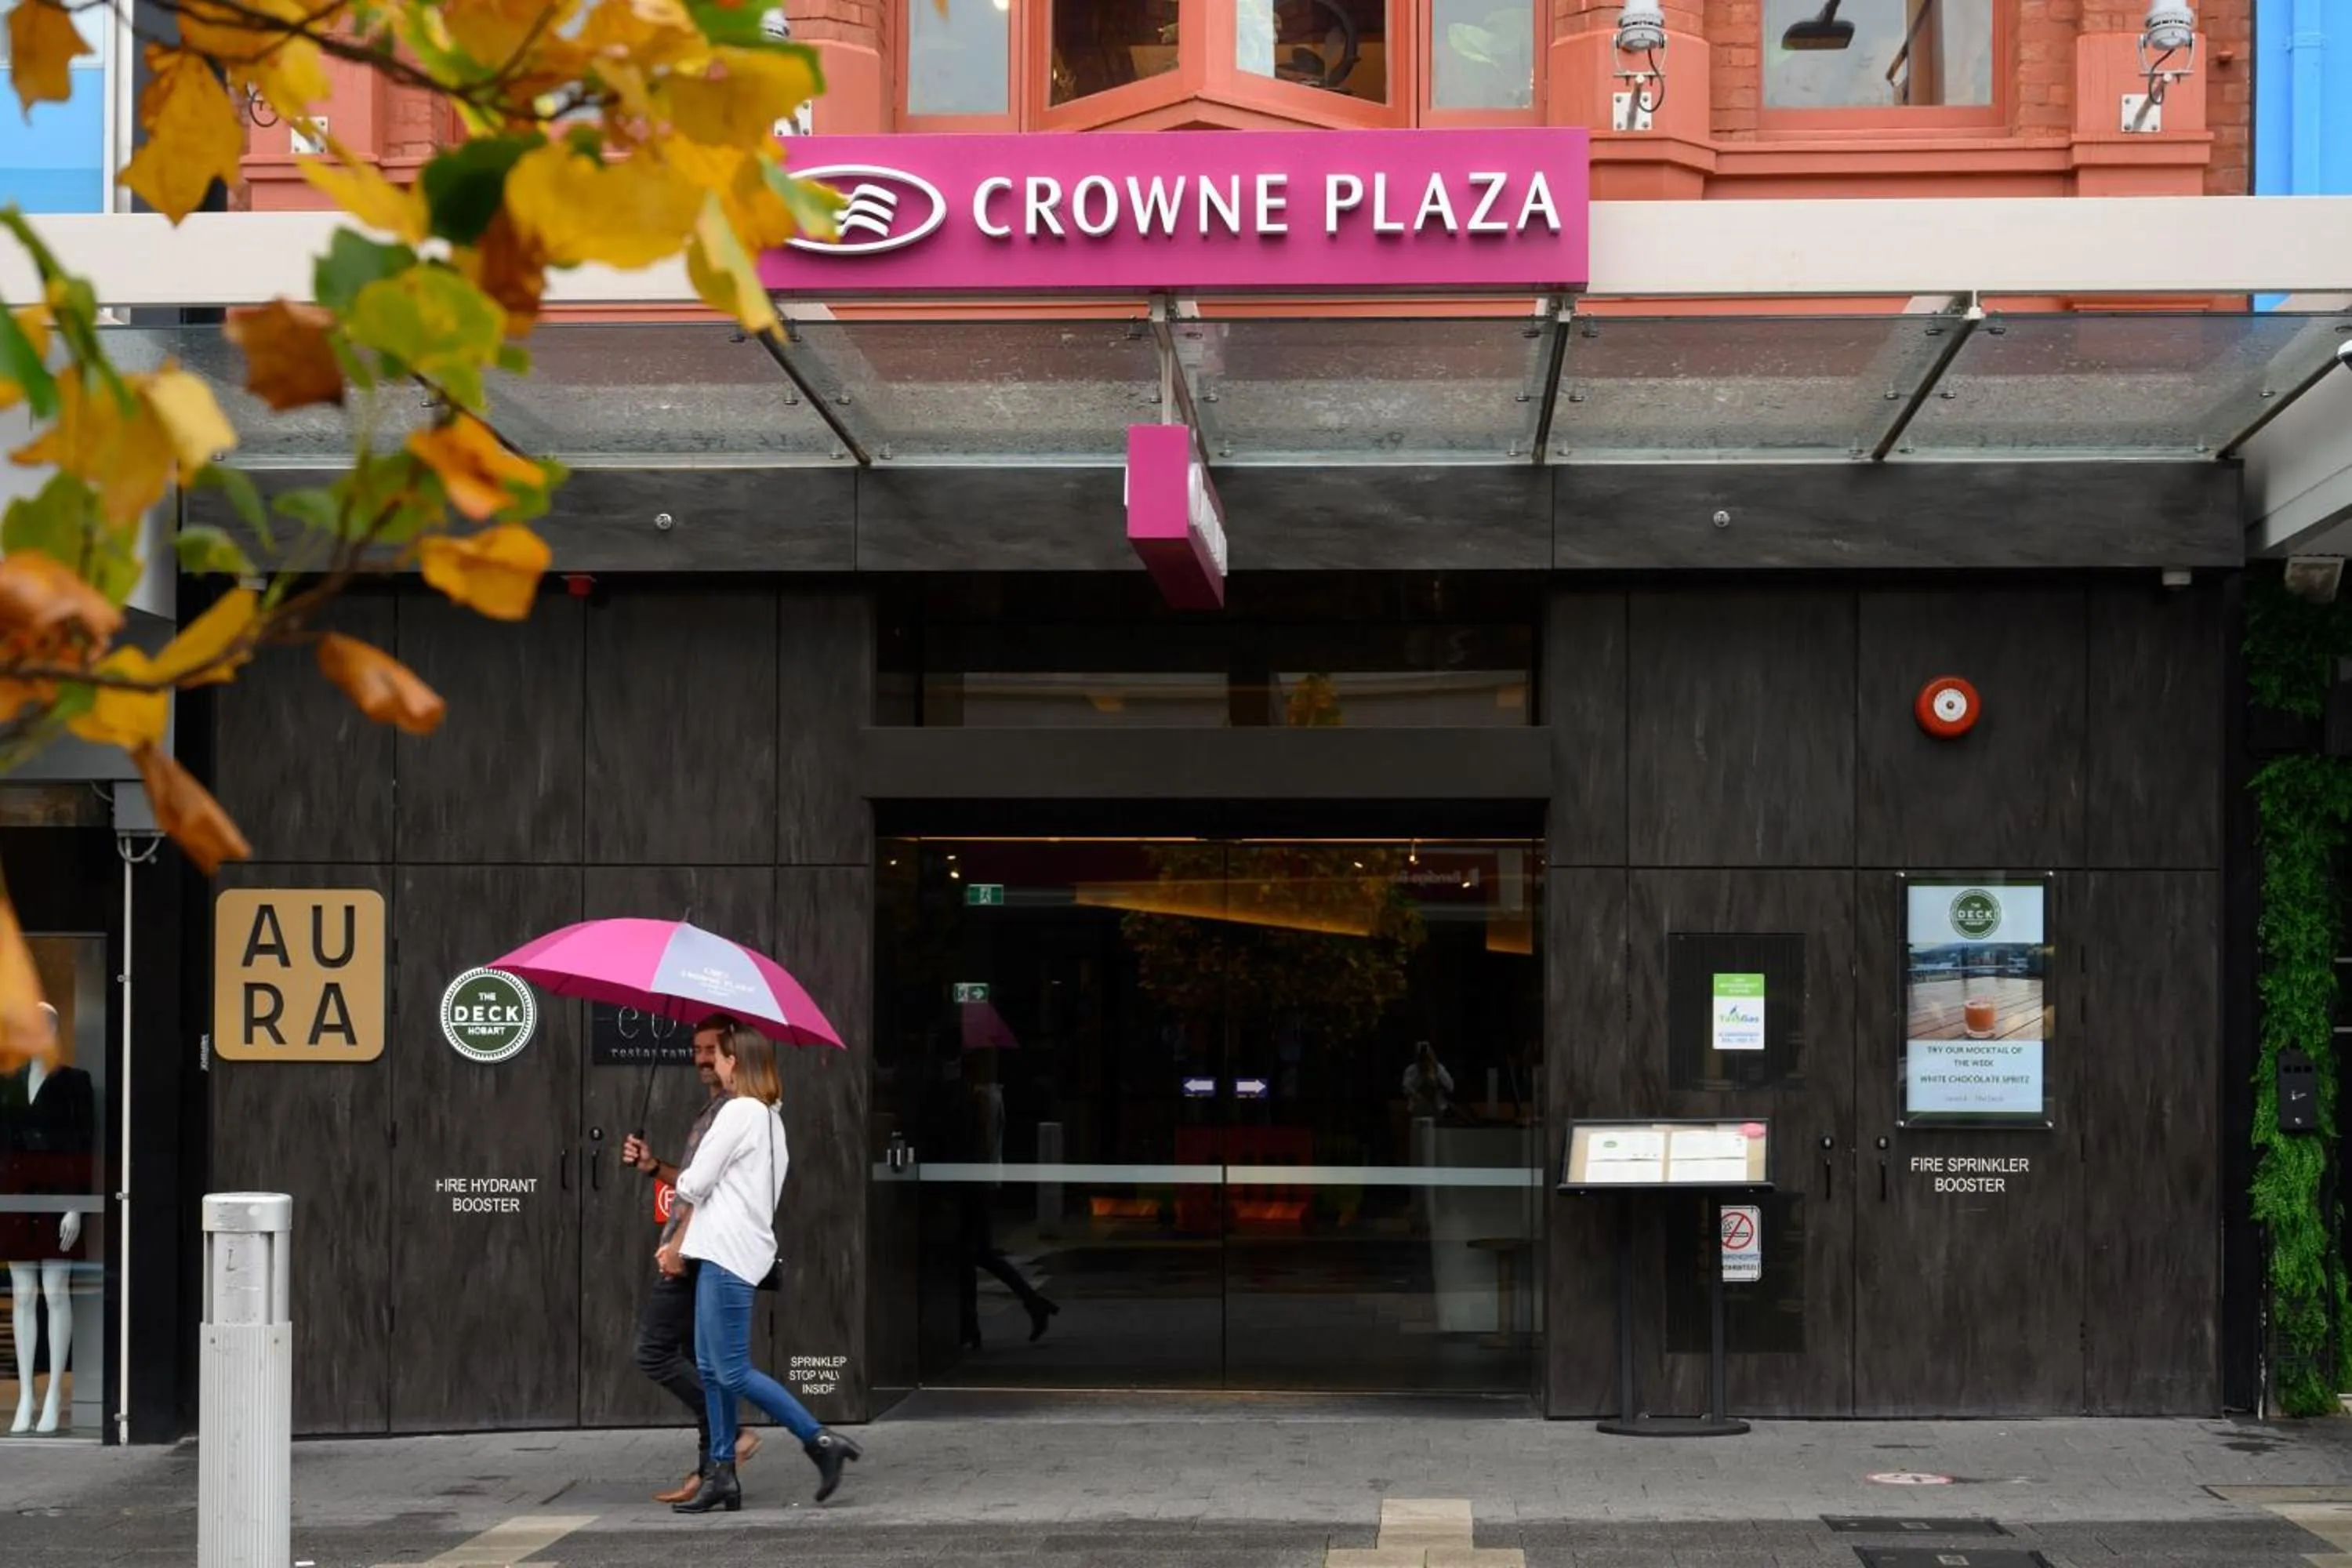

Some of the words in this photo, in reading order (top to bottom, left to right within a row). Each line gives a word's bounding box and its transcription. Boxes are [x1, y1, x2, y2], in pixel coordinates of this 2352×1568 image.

[972, 175, 1288, 238] CROWNE
[1325, 171, 1563, 236] PLAZA
[477, 992, 496, 1001] THE
[454, 1005, 519, 1022] DECK
[468, 1026, 506, 1036] HOBART
[1911, 1156, 1944, 1172] FIRE
[1947, 1156, 2030, 1172] SPRINKLER
[470, 1178, 538, 1192] HYDRANT
[1934, 1177, 2006, 1192] BOOSTER
[452, 1196, 521, 1212] BOOSTER
[789, 1370, 816, 1381] STOP
